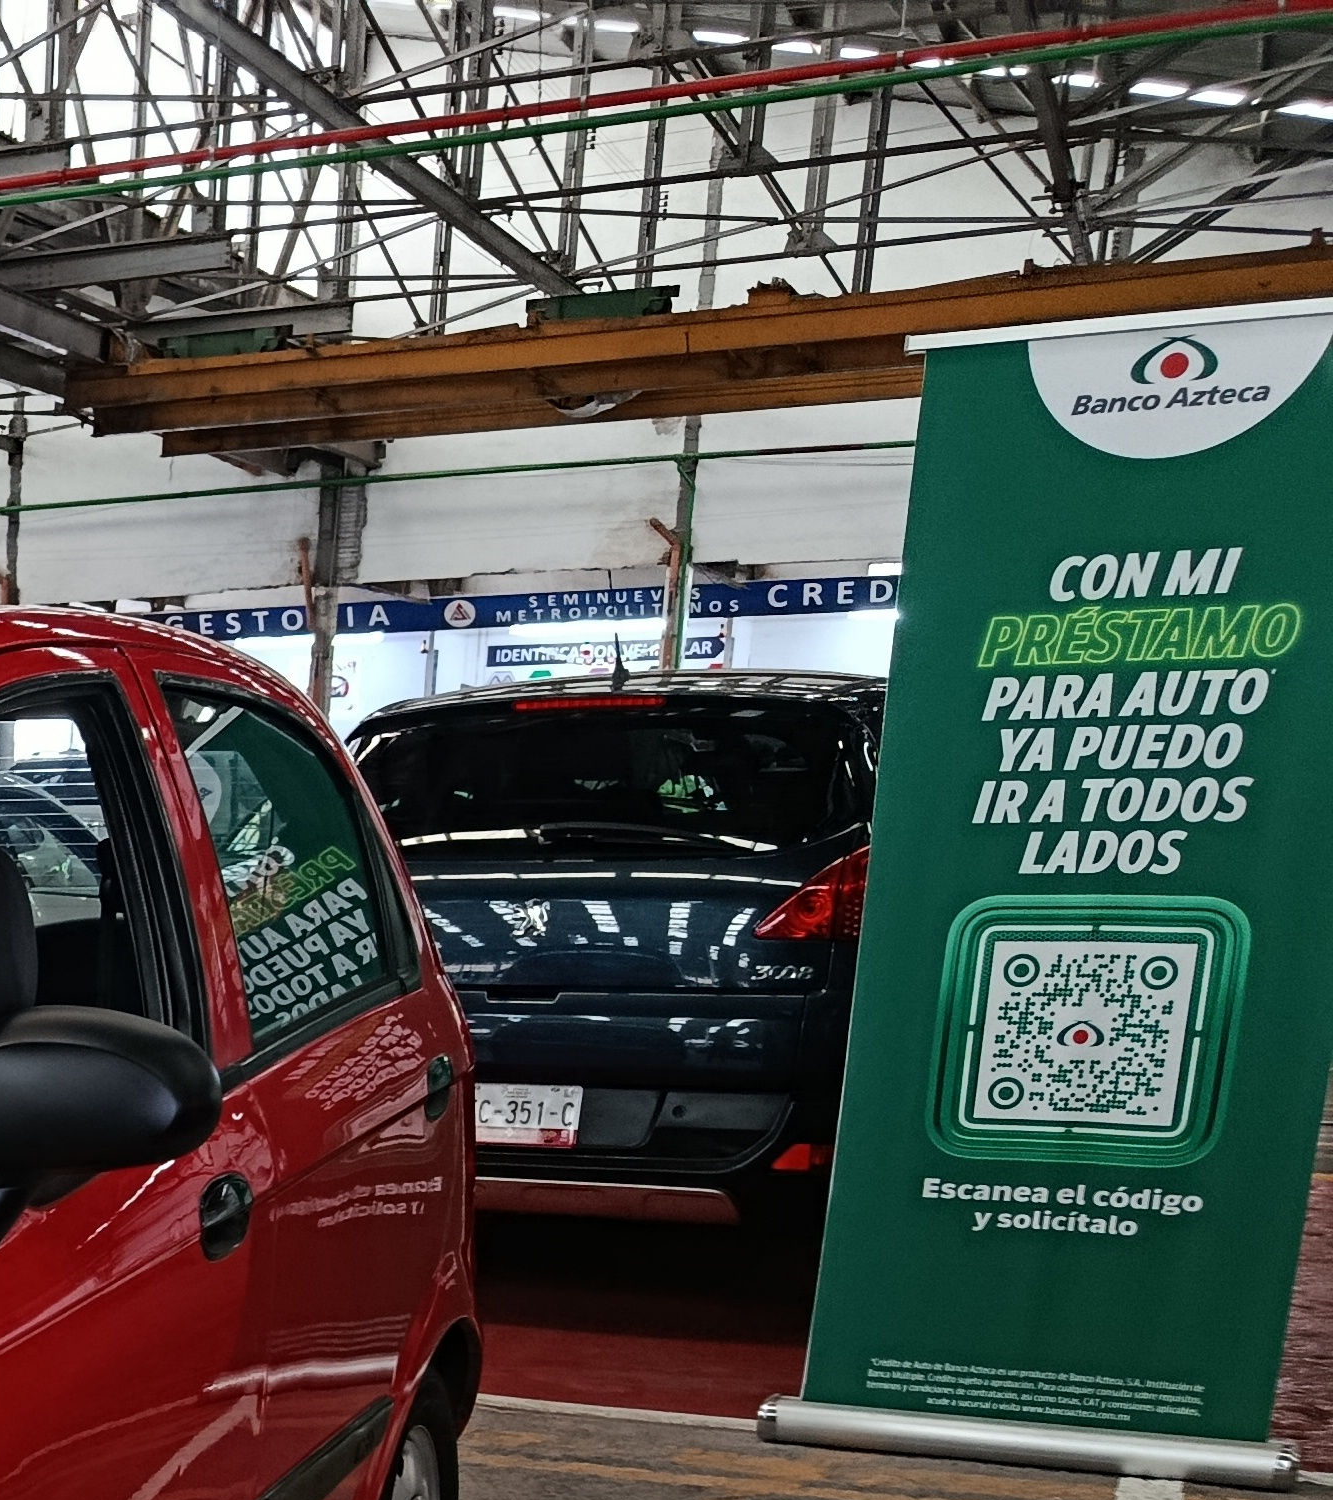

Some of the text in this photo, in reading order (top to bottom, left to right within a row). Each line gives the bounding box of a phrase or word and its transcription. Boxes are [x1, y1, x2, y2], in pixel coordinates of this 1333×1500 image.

[1071, 384, 1271, 416] Banco Azteca
[1049, 547, 1244, 602] CON MI
[496, 600, 740, 622] METROPOLITNOS
[529, 588, 701, 608] SEMINUEVS
[767, 579, 894, 608] CRED
[164, 604, 391, 635] GESTOIA
[976, 602, 1302, 668] PRÉSTAMO
[981, 672, 1114, 721] PARA
[997, 722, 1244, 772] YA PUEDO
[971, 776, 1255, 824] IR A TODOS
[1018, 829, 1188, 875] LADOS
[475, 1099, 575, 1127] C-351-C
[922, 1177, 1204, 1216] Escanea el código
[971, 1210, 1139, 1236] y solicítalo
